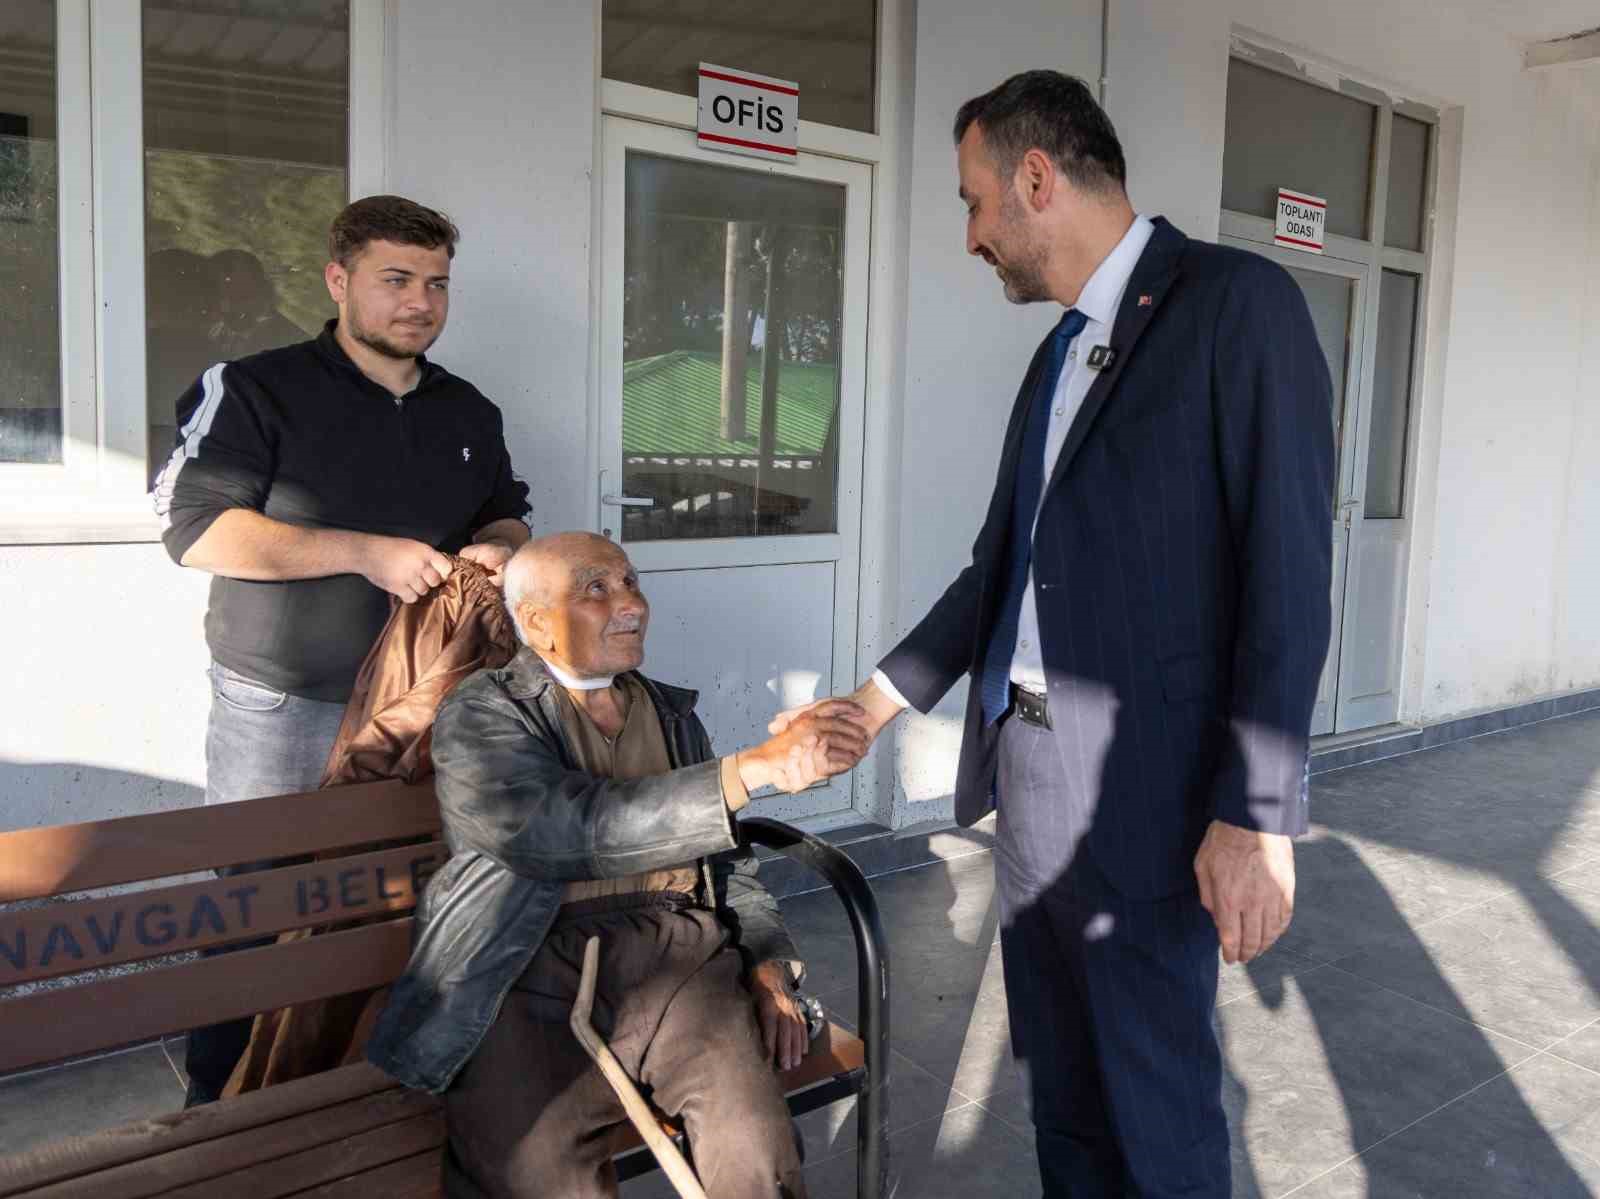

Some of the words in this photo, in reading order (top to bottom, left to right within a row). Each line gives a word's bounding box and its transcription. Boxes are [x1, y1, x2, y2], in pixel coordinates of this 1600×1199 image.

[712, 95, 784, 133] OFİS
[1279, 202, 1323, 225] TOPLANTI
[1286, 221, 1315, 239] ODASI
